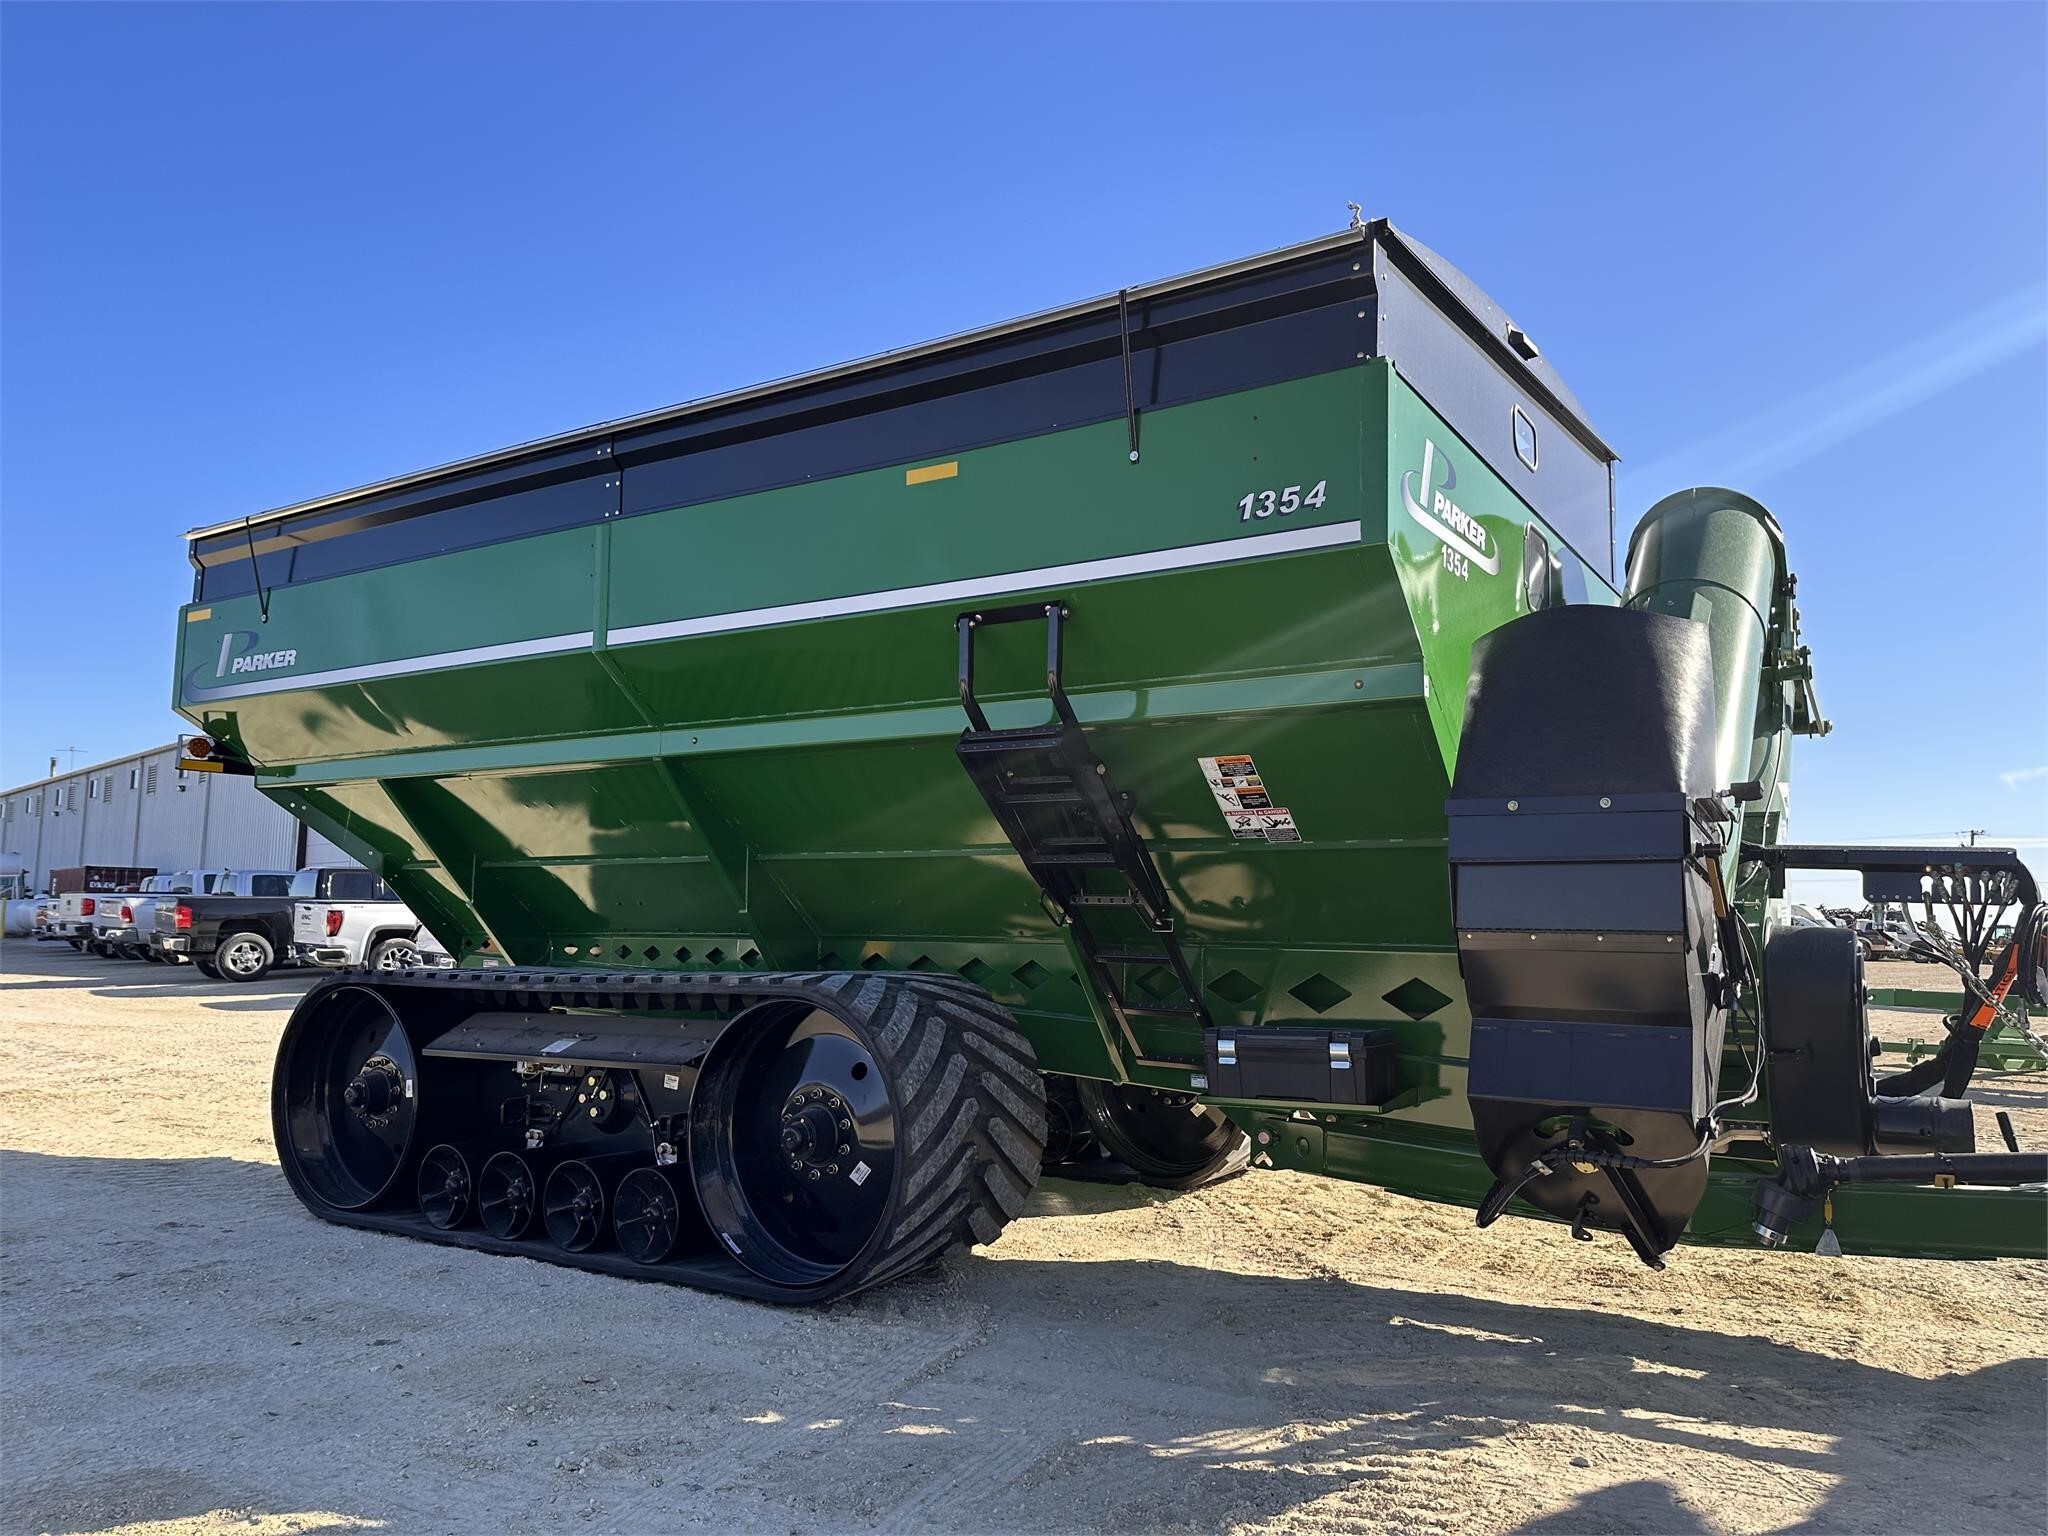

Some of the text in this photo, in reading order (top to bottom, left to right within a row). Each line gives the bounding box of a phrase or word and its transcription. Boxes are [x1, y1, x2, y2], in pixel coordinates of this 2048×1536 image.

[1237, 479, 1327, 523] 1354
[1433, 489, 1486, 551] PARKER
[1441, 544, 1469, 582] 1354
[231, 649, 297, 674] PARKER
